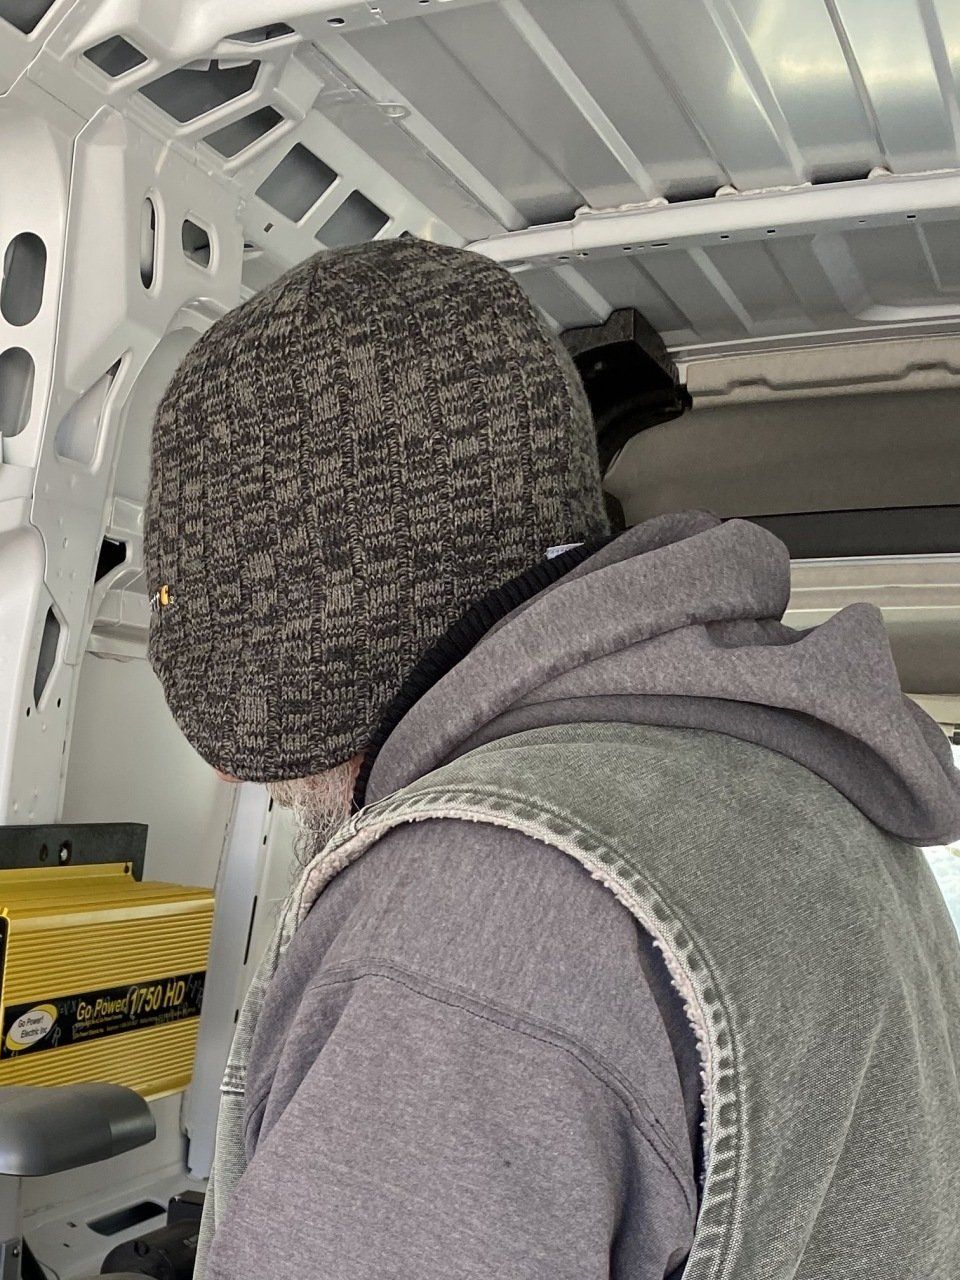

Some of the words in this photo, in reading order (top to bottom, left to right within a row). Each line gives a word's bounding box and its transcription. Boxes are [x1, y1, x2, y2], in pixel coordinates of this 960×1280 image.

[76, 1001, 91, 1021] Go
[94, 995, 131, 1016] Power!
[130, 984, 163, 1015] 1750
[163, 980, 186, 1008] HD
[17, 1018, 28, 1029] Go
[27, 1014, 44, 1027] Power!
[20, 1028, 40, 1039] Electric
